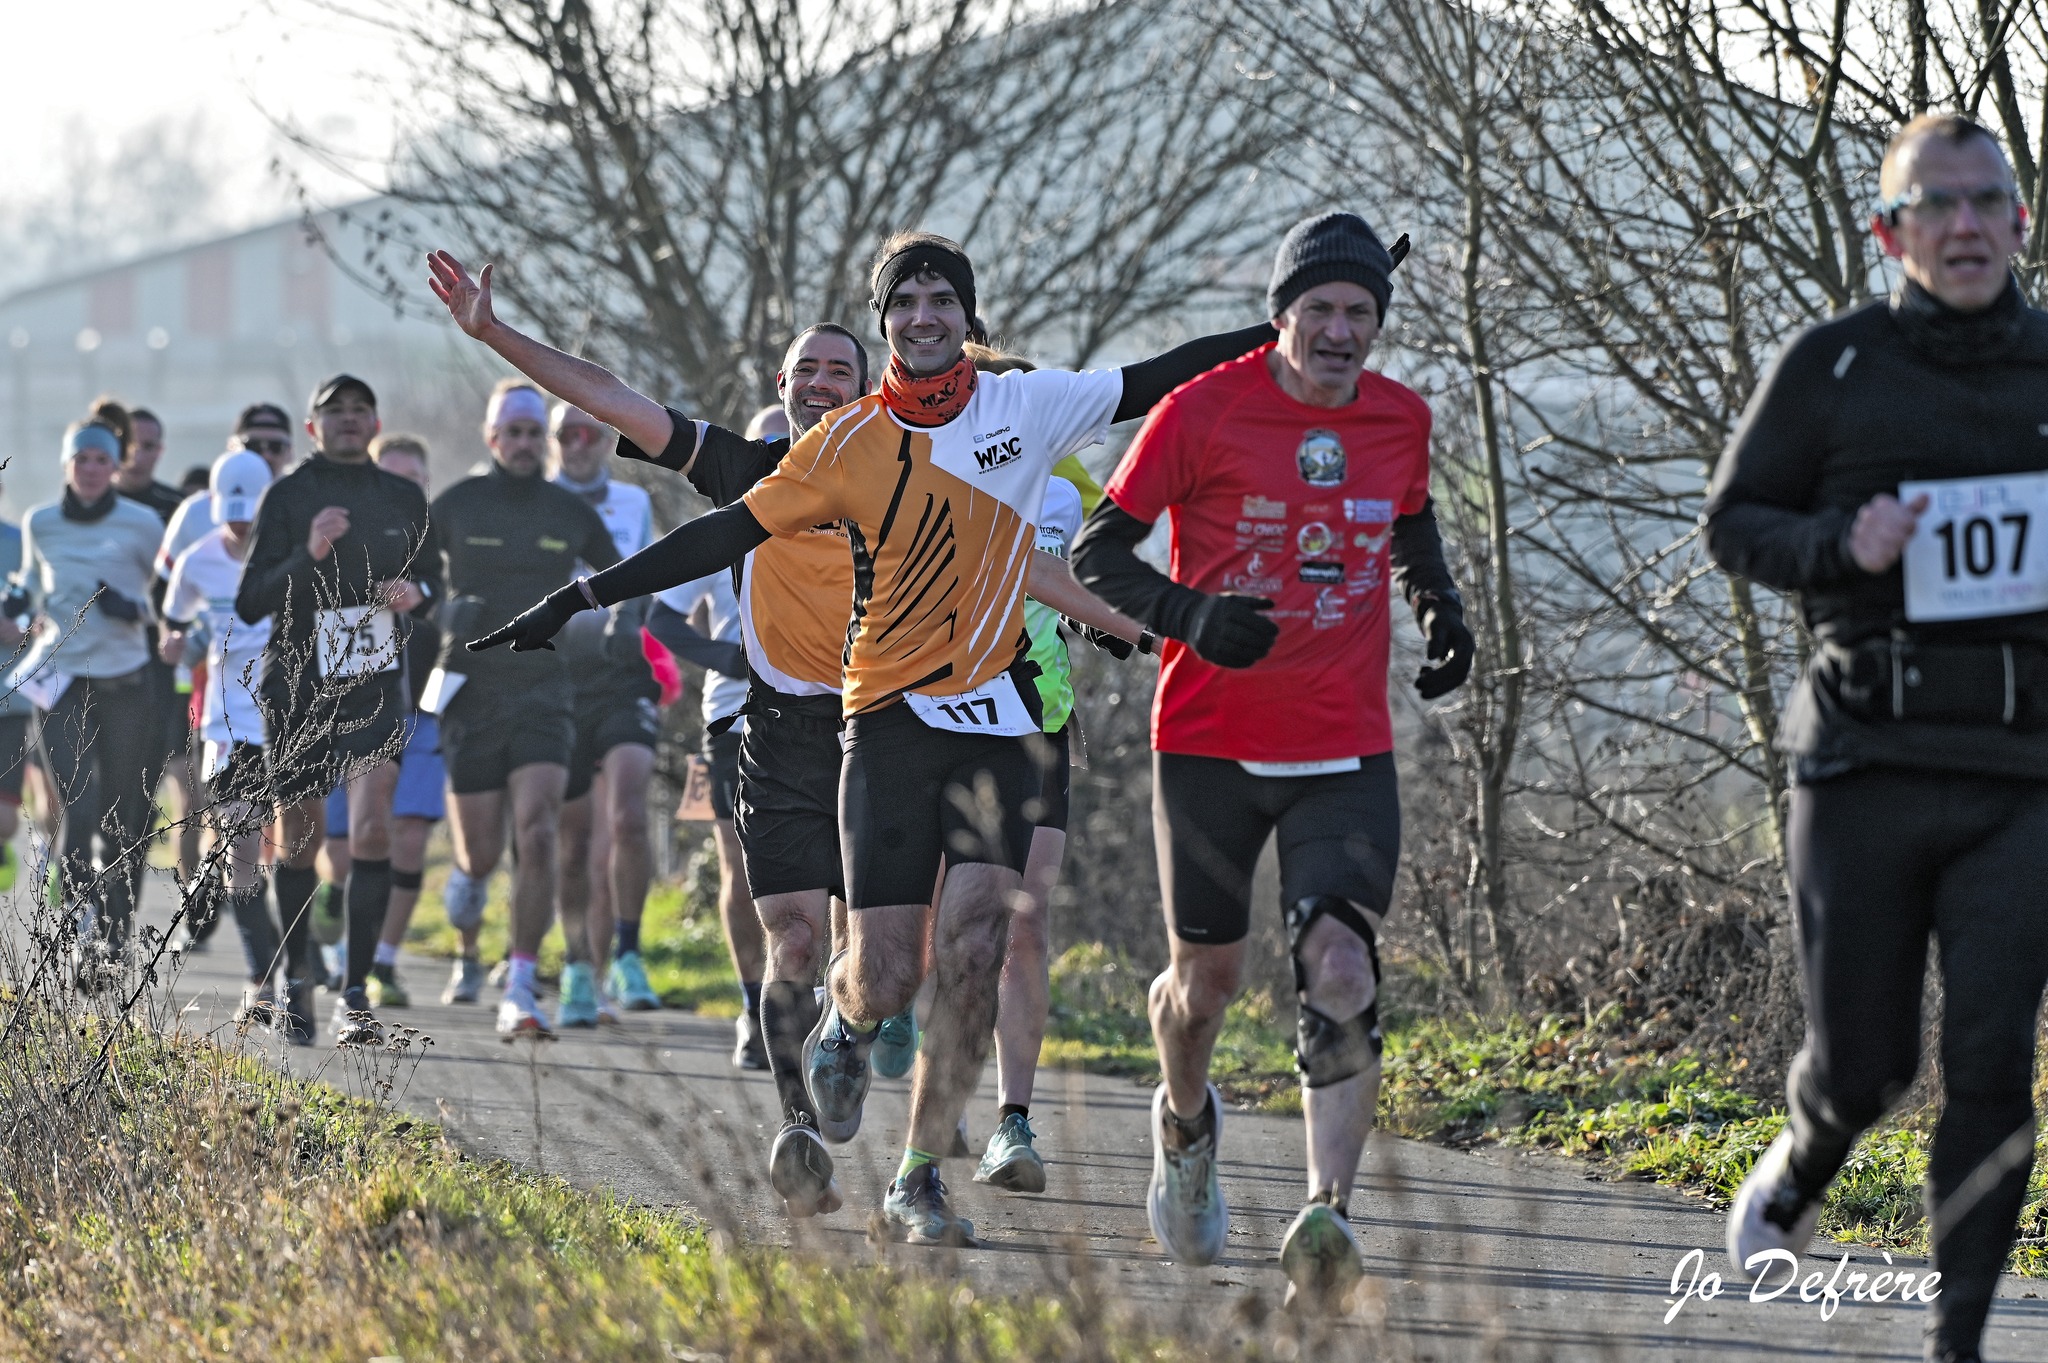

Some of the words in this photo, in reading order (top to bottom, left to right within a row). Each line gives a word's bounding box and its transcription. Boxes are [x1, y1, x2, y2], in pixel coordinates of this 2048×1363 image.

[973, 437, 1022, 470] WAC
[1932, 511, 2031, 580] 107
[937, 697, 999, 725] 117
